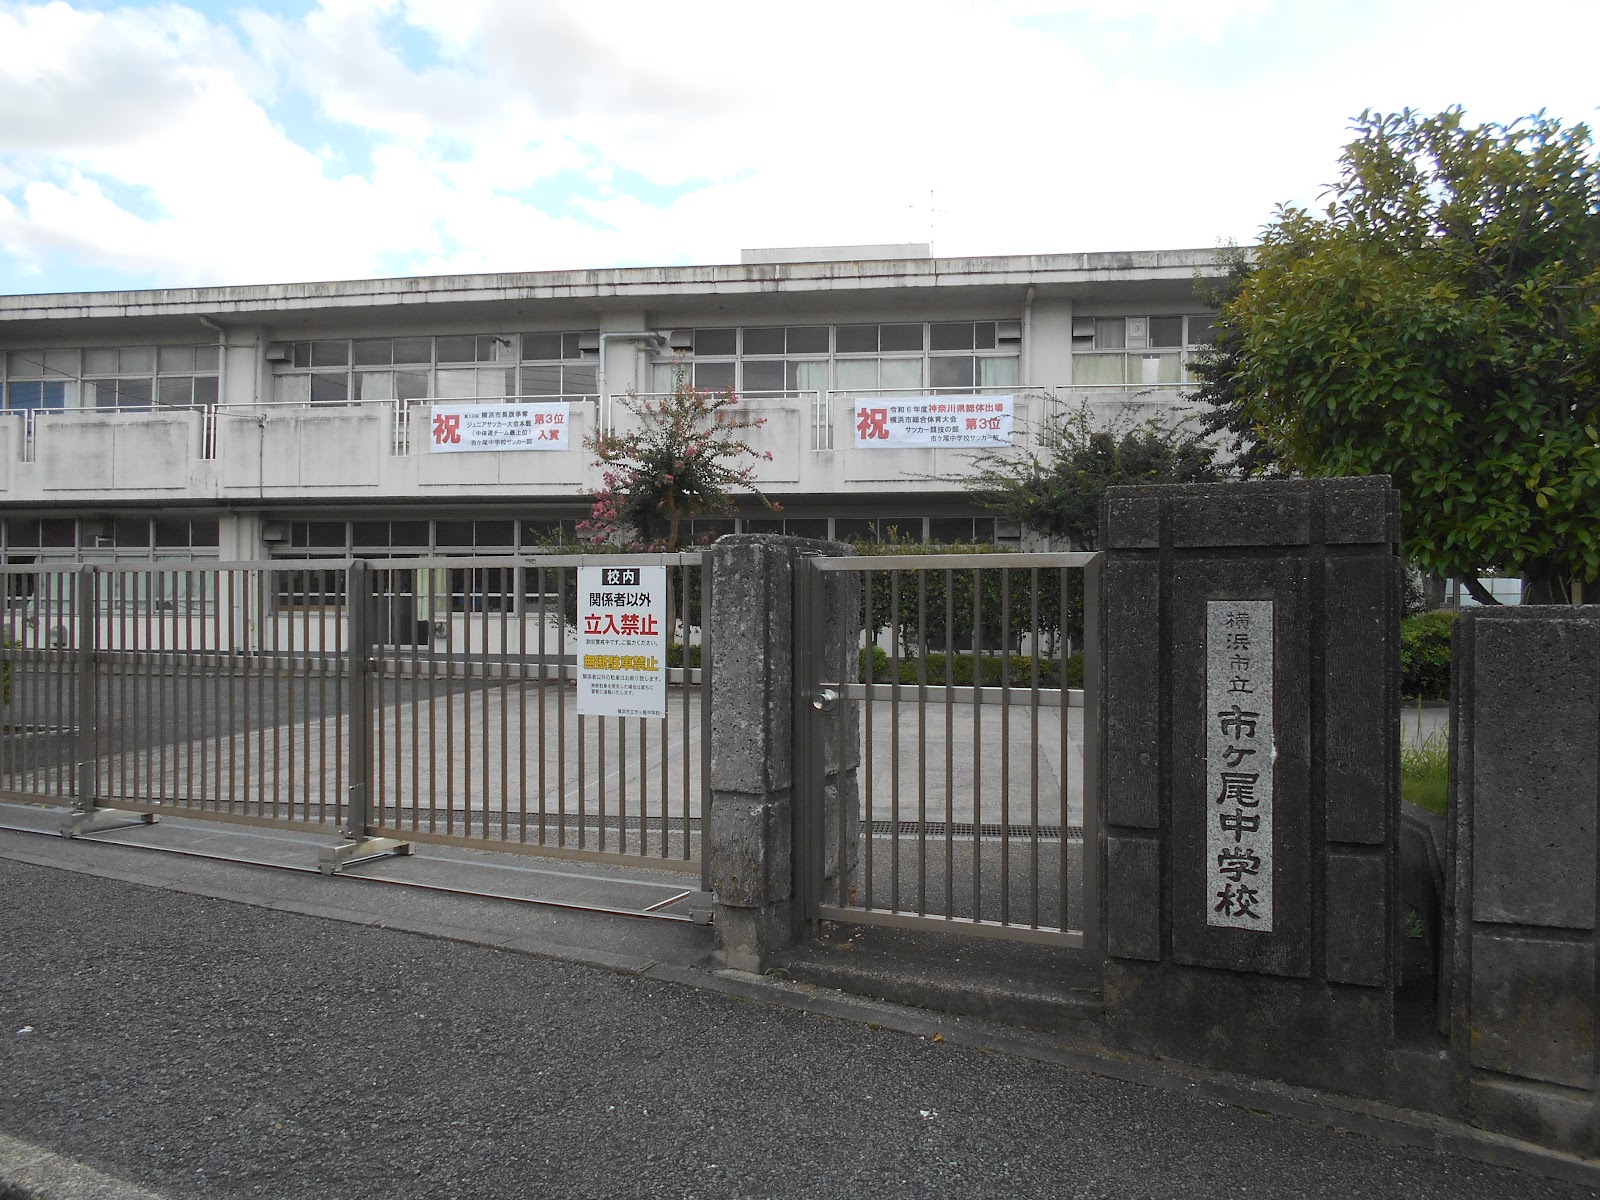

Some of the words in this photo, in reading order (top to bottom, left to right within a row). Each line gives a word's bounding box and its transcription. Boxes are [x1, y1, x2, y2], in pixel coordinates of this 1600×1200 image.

[928, 403, 1004, 412] 神奈川県総体出場
[534, 413, 565, 425] 第3位
[856, 407, 889, 440] 祝
[890, 415, 957, 424] 横浜市総合体育大会
[965, 417, 1001, 430] 第3位
[433, 413, 461, 444] 祝
[537, 429, 560, 441] 入賞
[607, 569, 635, 585] 校内
[589, 592, 652, 608] 関係者以外
[584, 613, 659, 636] 立入禁止
[1222, 611, 1254, 694] 横浜市立
[583, 654, 659, 671] 無断駐車禁止
